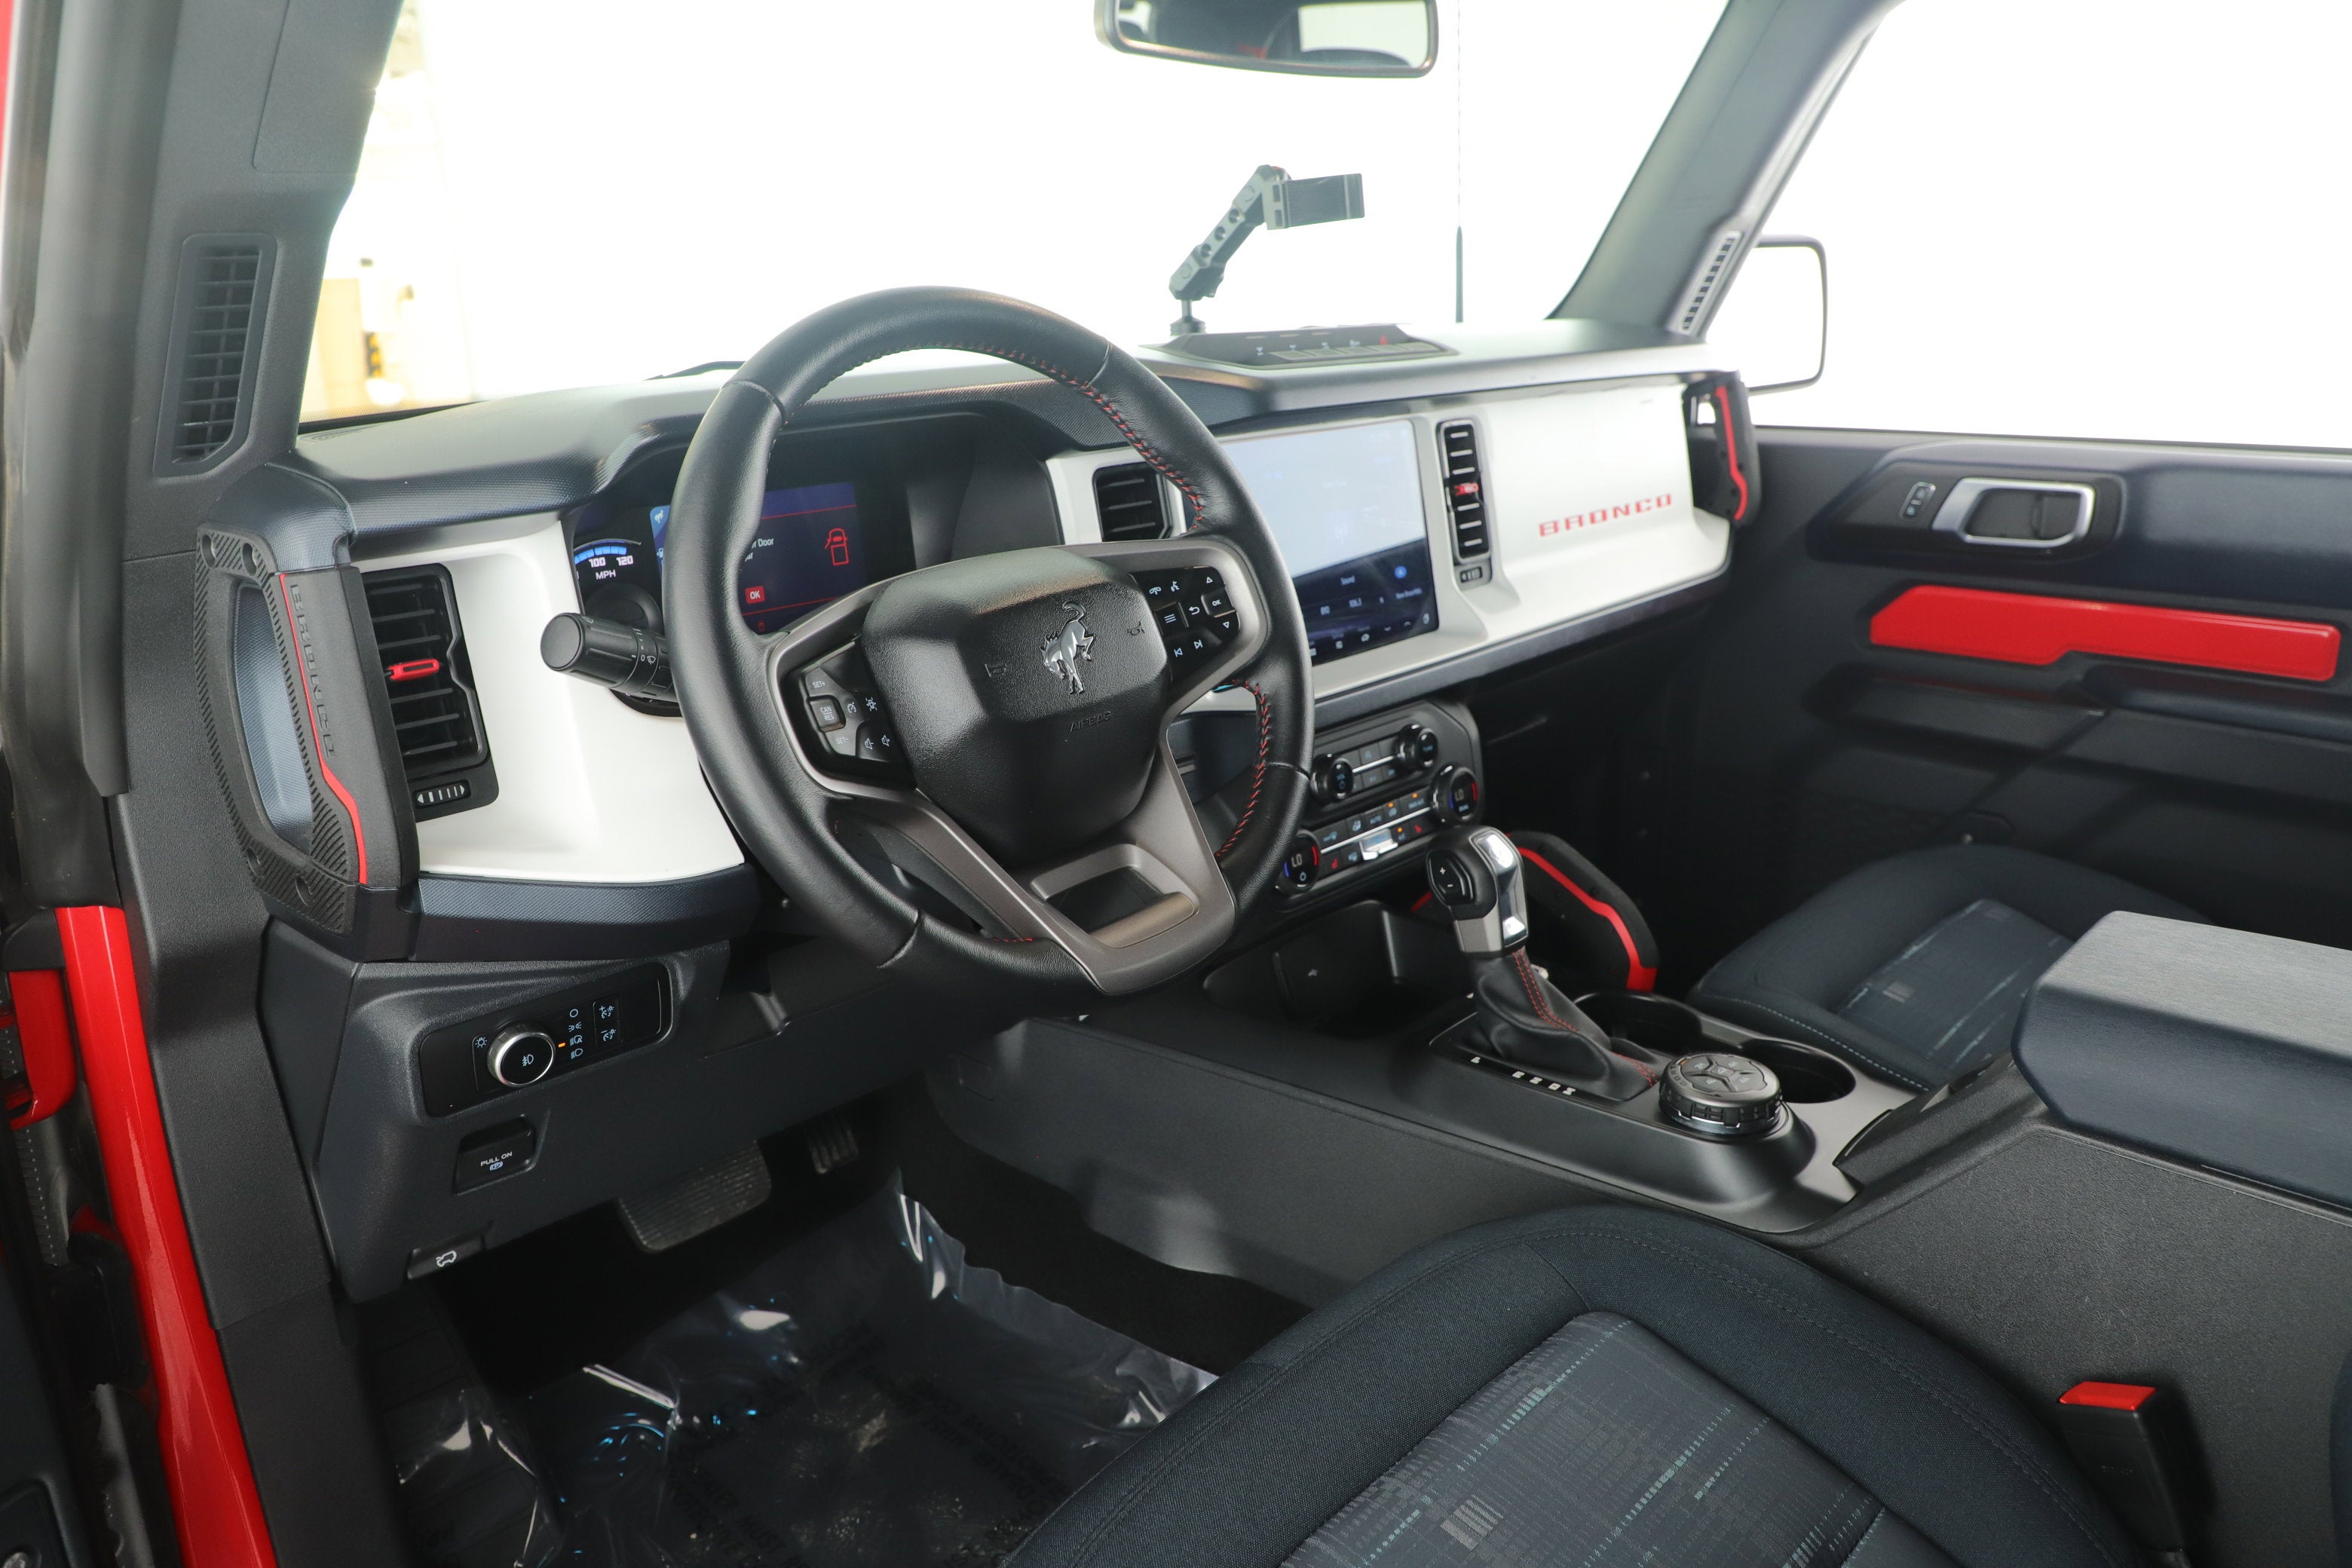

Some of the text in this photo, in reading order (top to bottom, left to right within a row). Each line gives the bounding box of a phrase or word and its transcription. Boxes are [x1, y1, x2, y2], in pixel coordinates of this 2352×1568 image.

[1538, 493, 1672, 537] BRONCO
[758, 538, 774, 547] Door
[589, 555, 634, 568] 100 120
[595, 569, 616, 580] MPH
[749, 590, 761, 599] OK
[289, 584, 335, 760] BRONCO
[1070, 711, 1112, 732] AIRBAG
[480, 1151, 513, 1167] PULL ON
[732, 1512, 788, 1557] MUST
